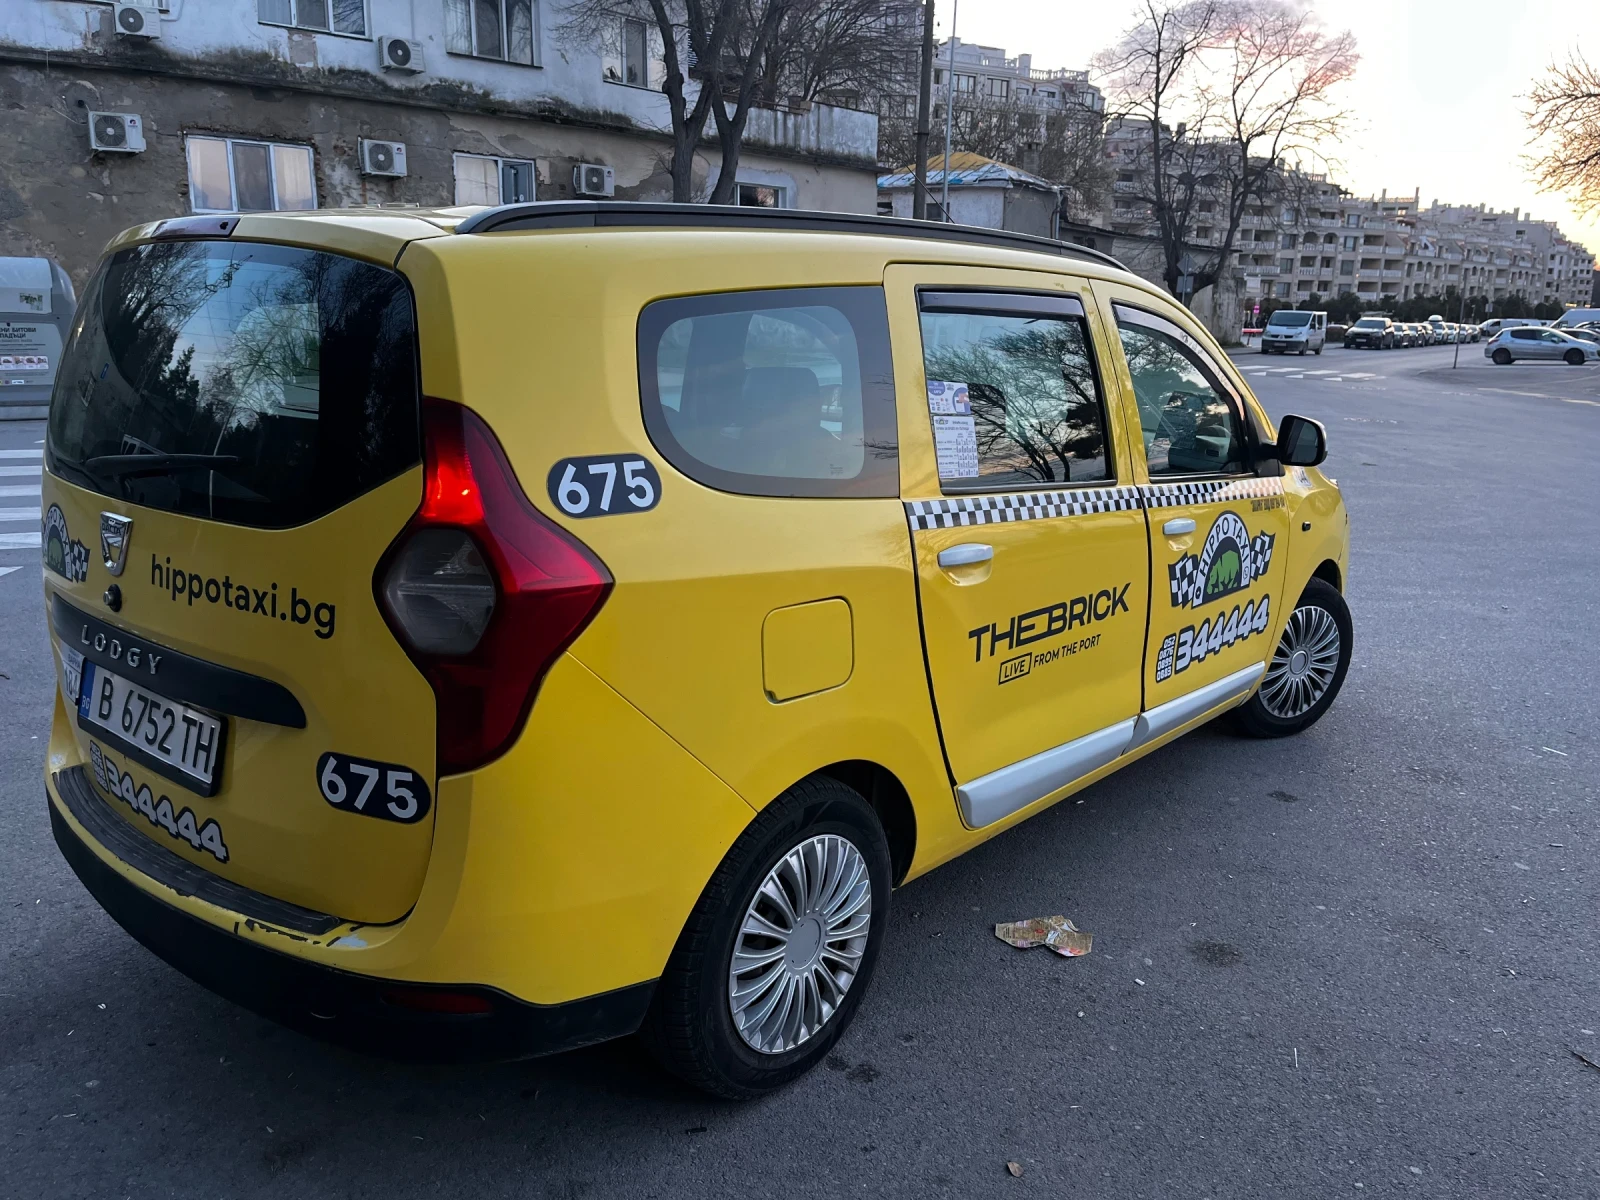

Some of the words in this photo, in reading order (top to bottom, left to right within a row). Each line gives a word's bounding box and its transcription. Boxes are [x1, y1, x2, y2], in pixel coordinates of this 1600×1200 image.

[557, 460, 655, 515] 675
[1199, 517, 1230, 577] HIPPO
[1232, 517, 1250, 564] TAXI
[150, 553, 337, 640] hippotaxi.bg
[80, 624, 163, 675] LODGY
[1003, 659, 1026, 679] LIVE
[1033, 648, 1060, 668] FROM
[1061, 642, 1078, 659] THE
[1078, 634, 1102, 652] PORT
[1174, 593, 1270, 675] 344444
[82, 694, 91, 710] BG
[98, 675, 114, 721] B
[121, 689, 177, 756] 6752
[104, 754, 230, 863] 344444
[320, 755, 419, 819] 675
